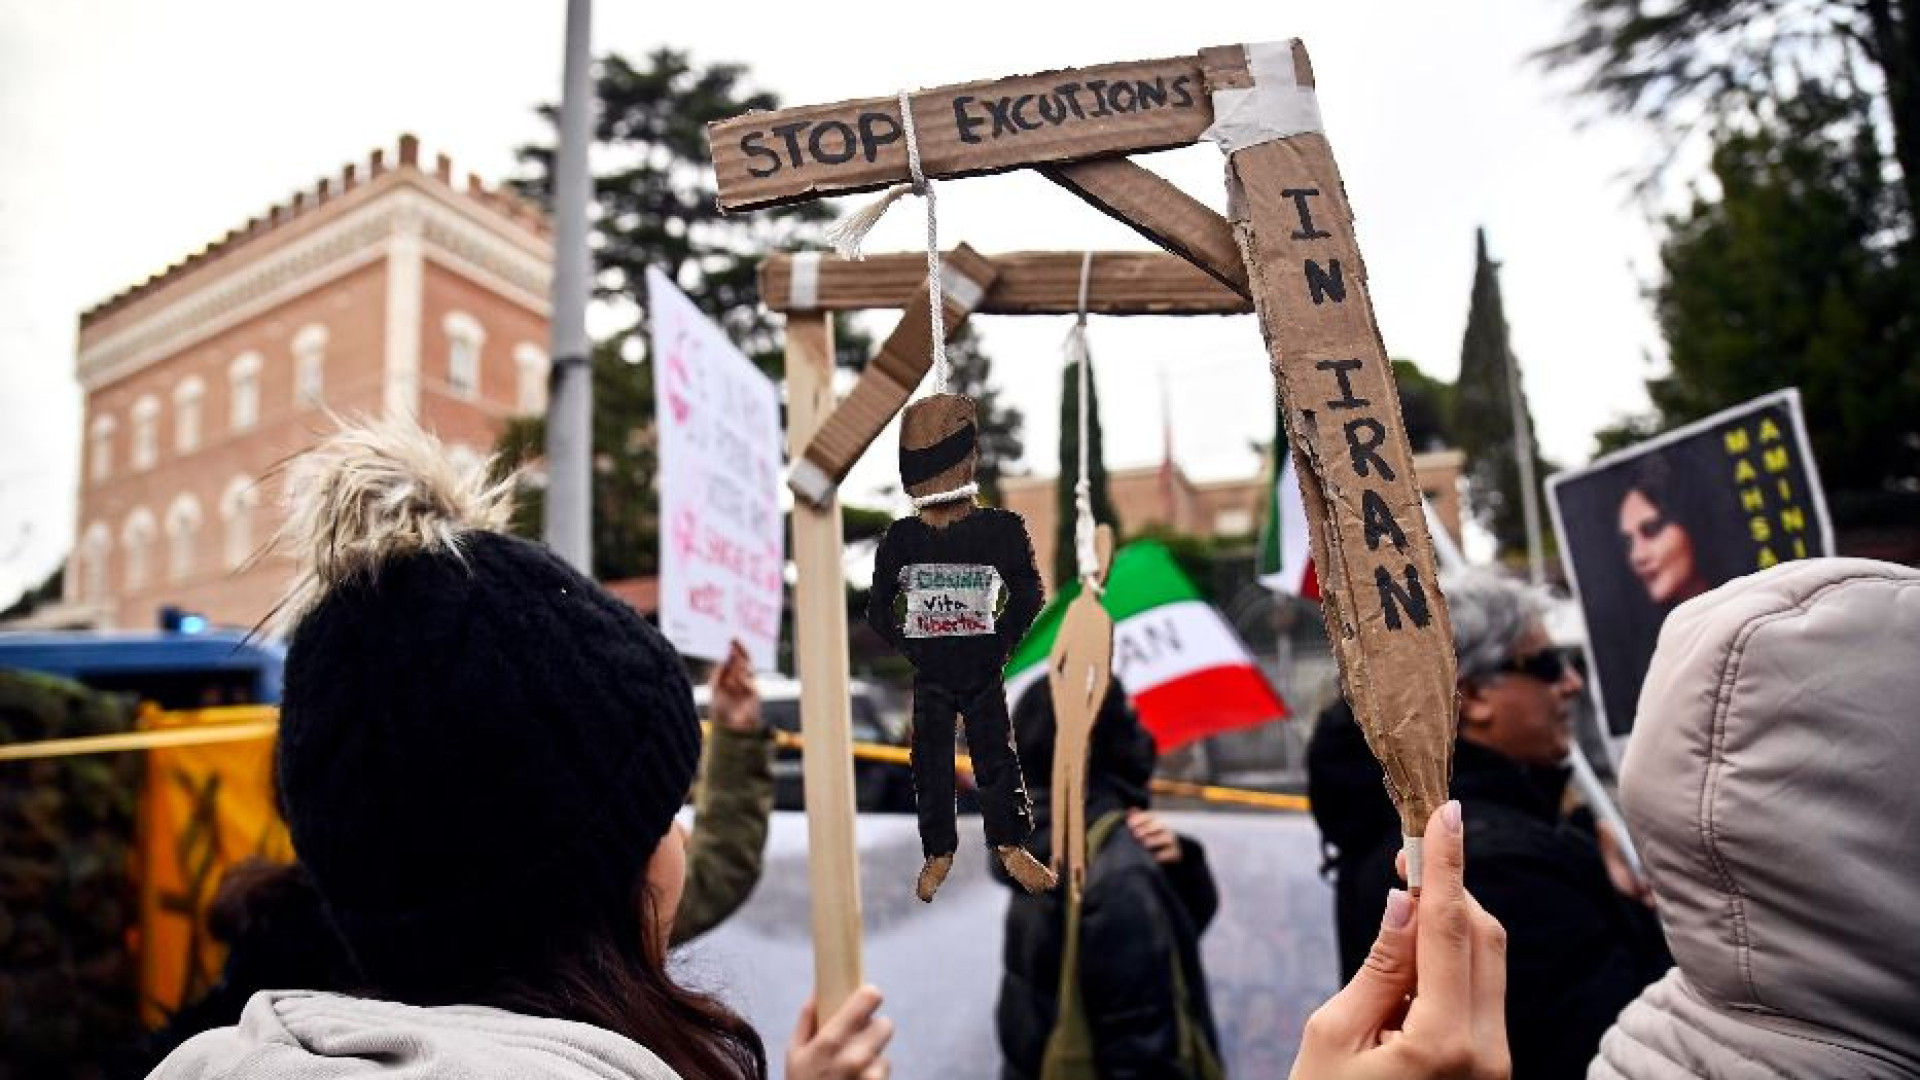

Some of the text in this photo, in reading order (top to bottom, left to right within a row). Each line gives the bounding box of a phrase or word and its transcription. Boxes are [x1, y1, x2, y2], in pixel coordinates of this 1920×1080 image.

[740, 74, 1195, 178] STOP EXCUTIONS
[1281, 187, 1432, 631] IN IRAN
[1724, 427, 1779, 569] MAHSA
[1759, 417, 1807, 559] AMINI
